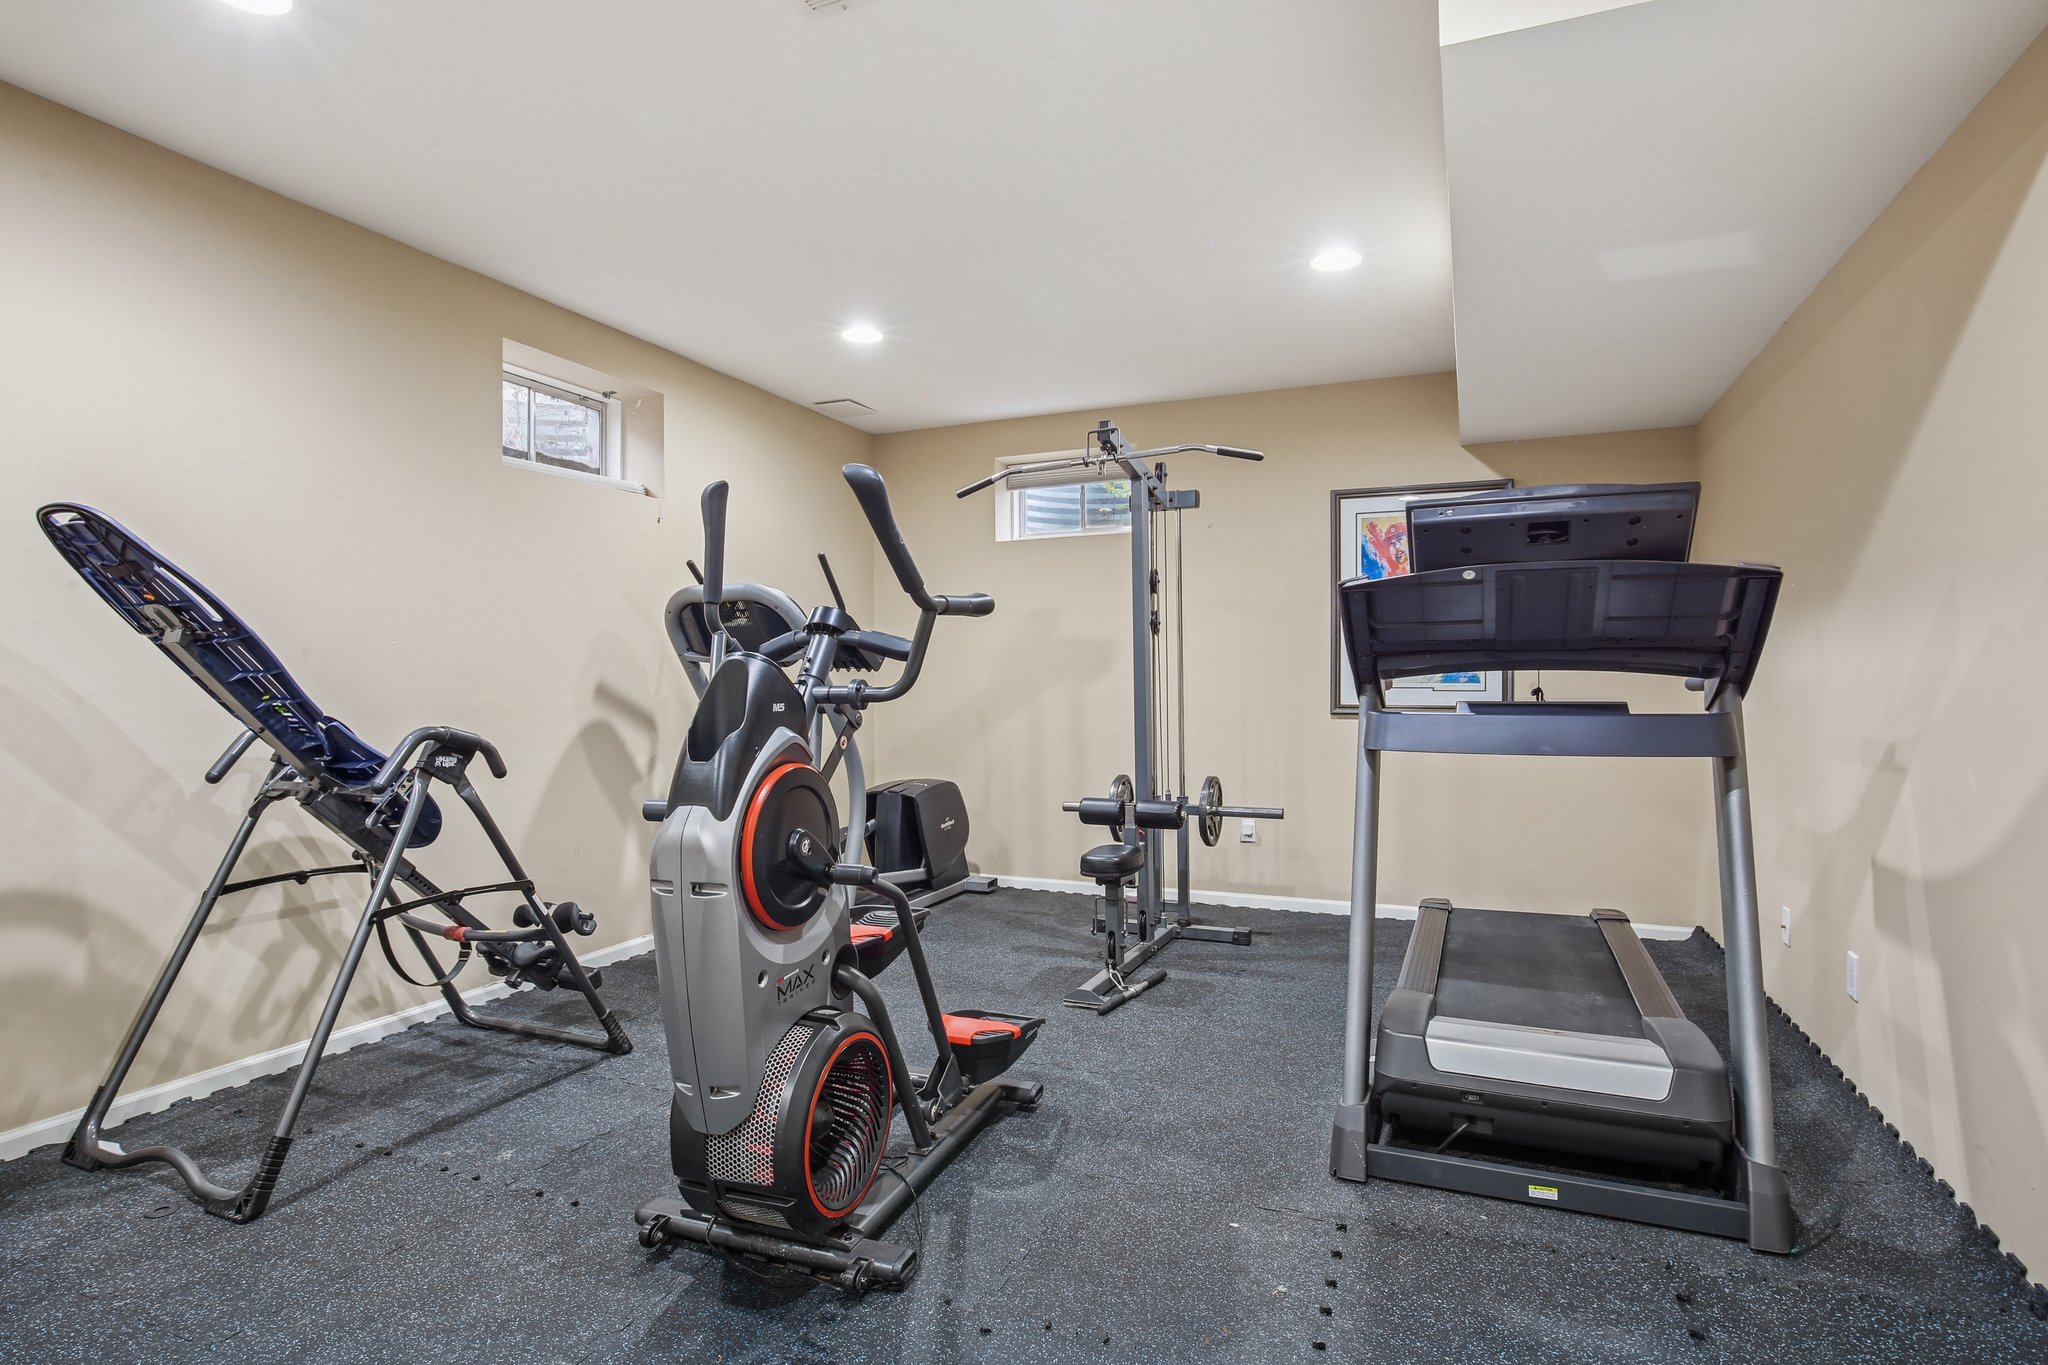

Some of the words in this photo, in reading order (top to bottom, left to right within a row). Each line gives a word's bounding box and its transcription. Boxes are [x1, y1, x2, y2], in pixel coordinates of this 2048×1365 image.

[772, 703, 785, 712] M5
[777, 964, 814, 1001] MAX
[777, 979, 816, 1006] TRAINER
